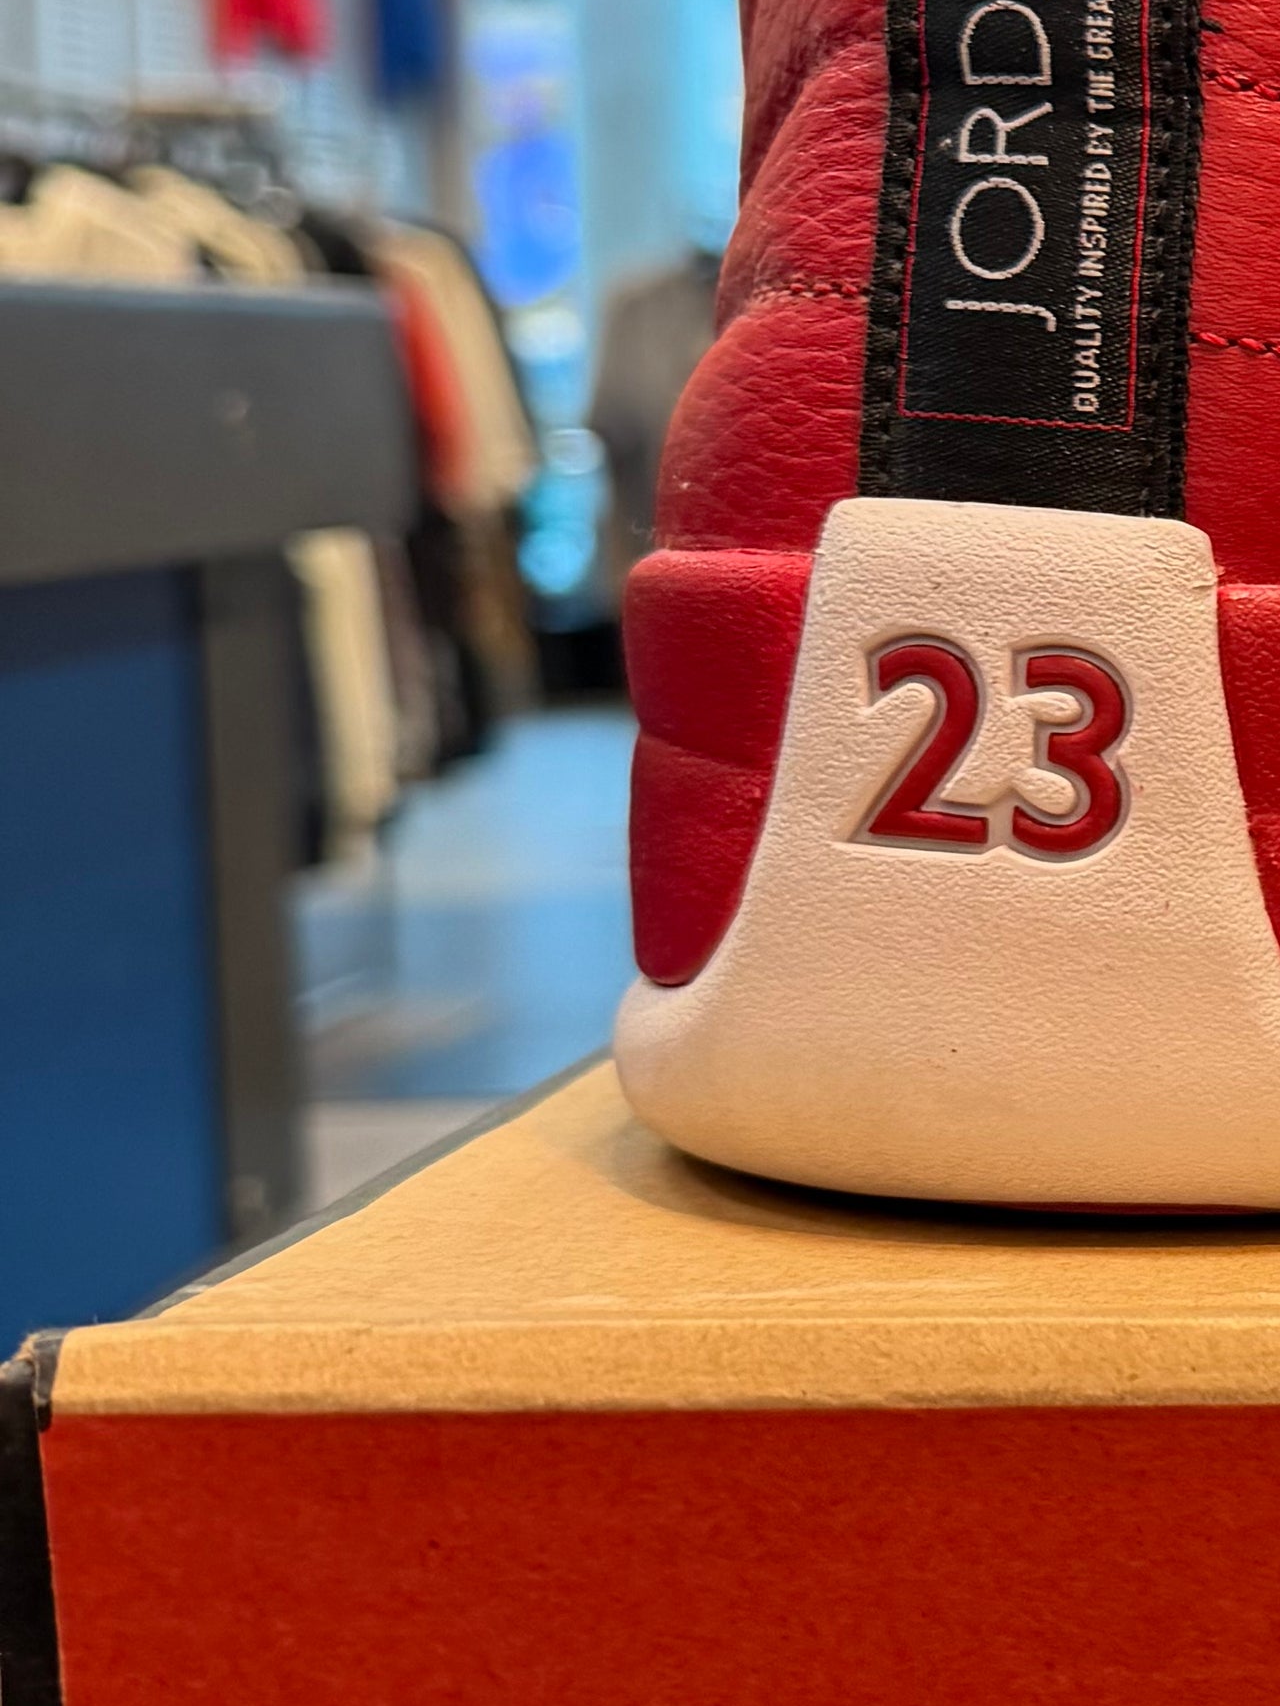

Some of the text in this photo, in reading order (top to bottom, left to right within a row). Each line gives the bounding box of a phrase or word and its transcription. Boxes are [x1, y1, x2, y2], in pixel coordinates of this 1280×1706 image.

[1084, 123, 1115, 156] BY
[1086, 69, 1116, 114] THE
[1077, 163, 1113, 277] INSPIRED
[1072, 285, 1103, 413] QUALITY
[854, 635, 1131, 860] 23
